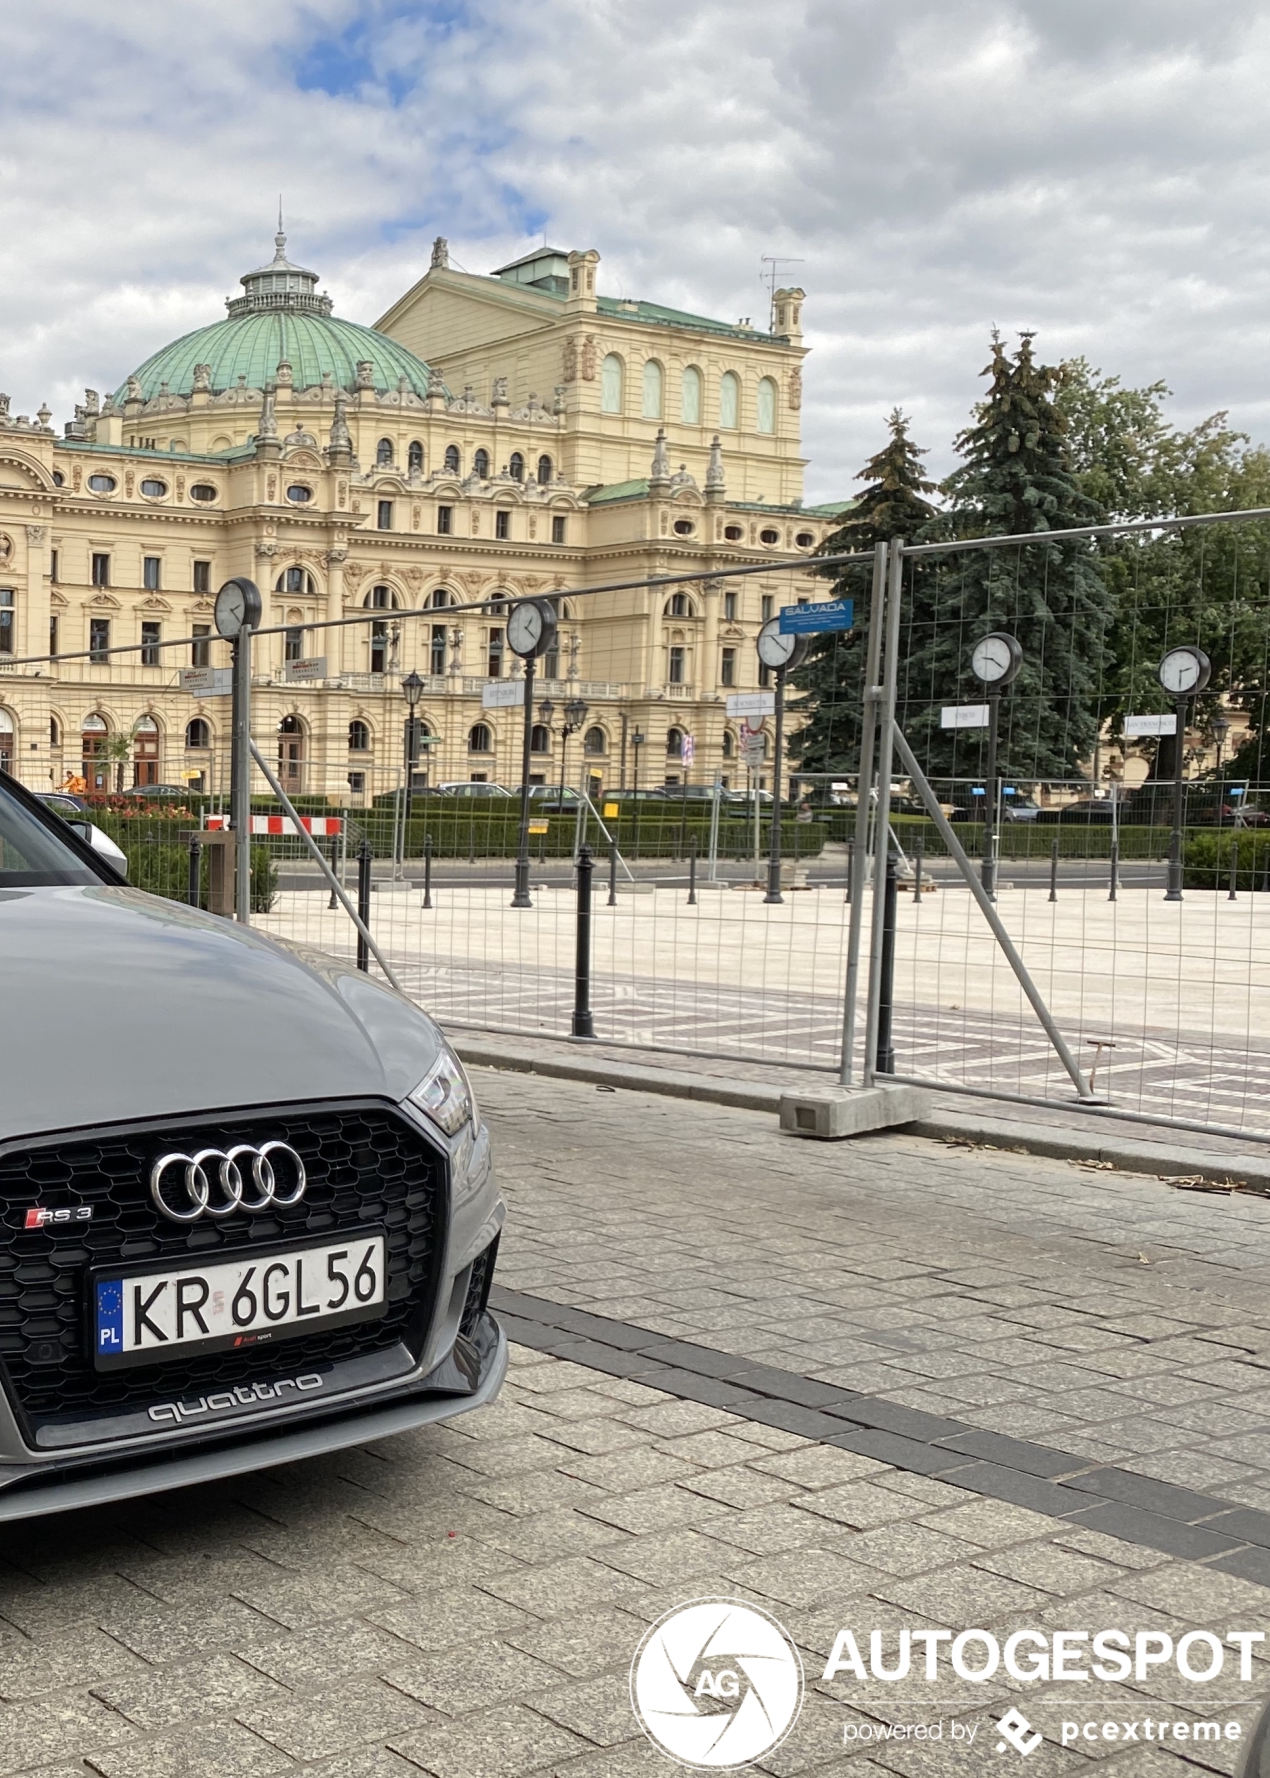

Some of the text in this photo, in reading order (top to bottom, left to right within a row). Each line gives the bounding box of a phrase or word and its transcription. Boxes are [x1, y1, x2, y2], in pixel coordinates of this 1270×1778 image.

[785, 602, 847, 616] SALVADA
[34, 1206, 93, 1225] RS 3
[133, 1244, 376, 1346] KR 6GL56
[100, 1327, 120, 1346] PL
[147, 1373, 324, 1423] quattro
